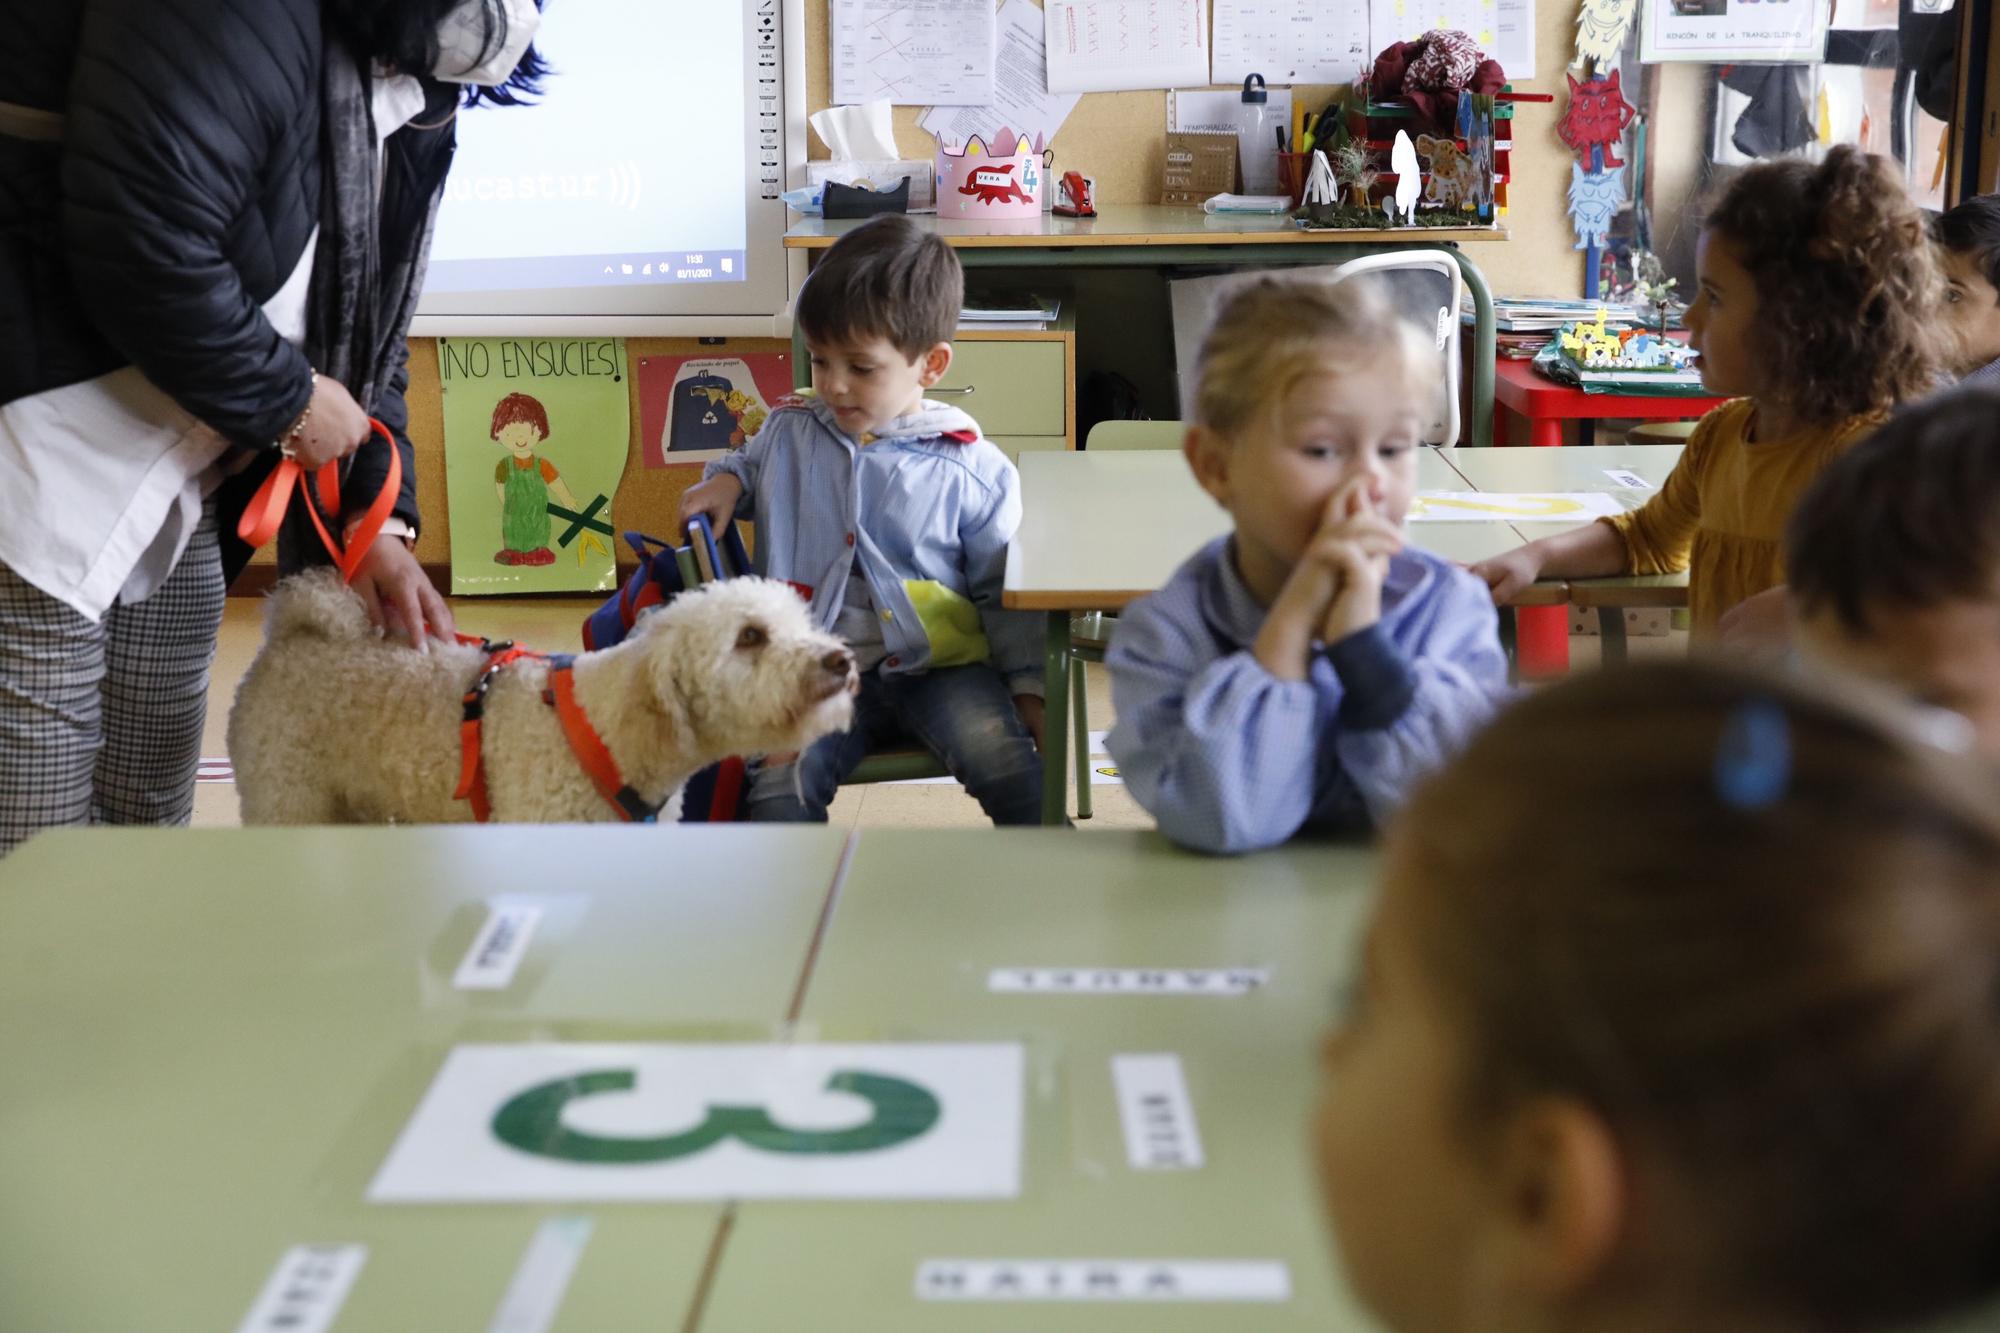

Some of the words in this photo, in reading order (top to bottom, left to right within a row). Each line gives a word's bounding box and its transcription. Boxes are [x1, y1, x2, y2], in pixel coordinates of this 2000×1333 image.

[1725, 31, 1735, 39] LA
[1023, 159, 1038, 193] 4
[501, 337, 621, 382] ENSUCIES!
[489, 1067, 942, 1167] 3
